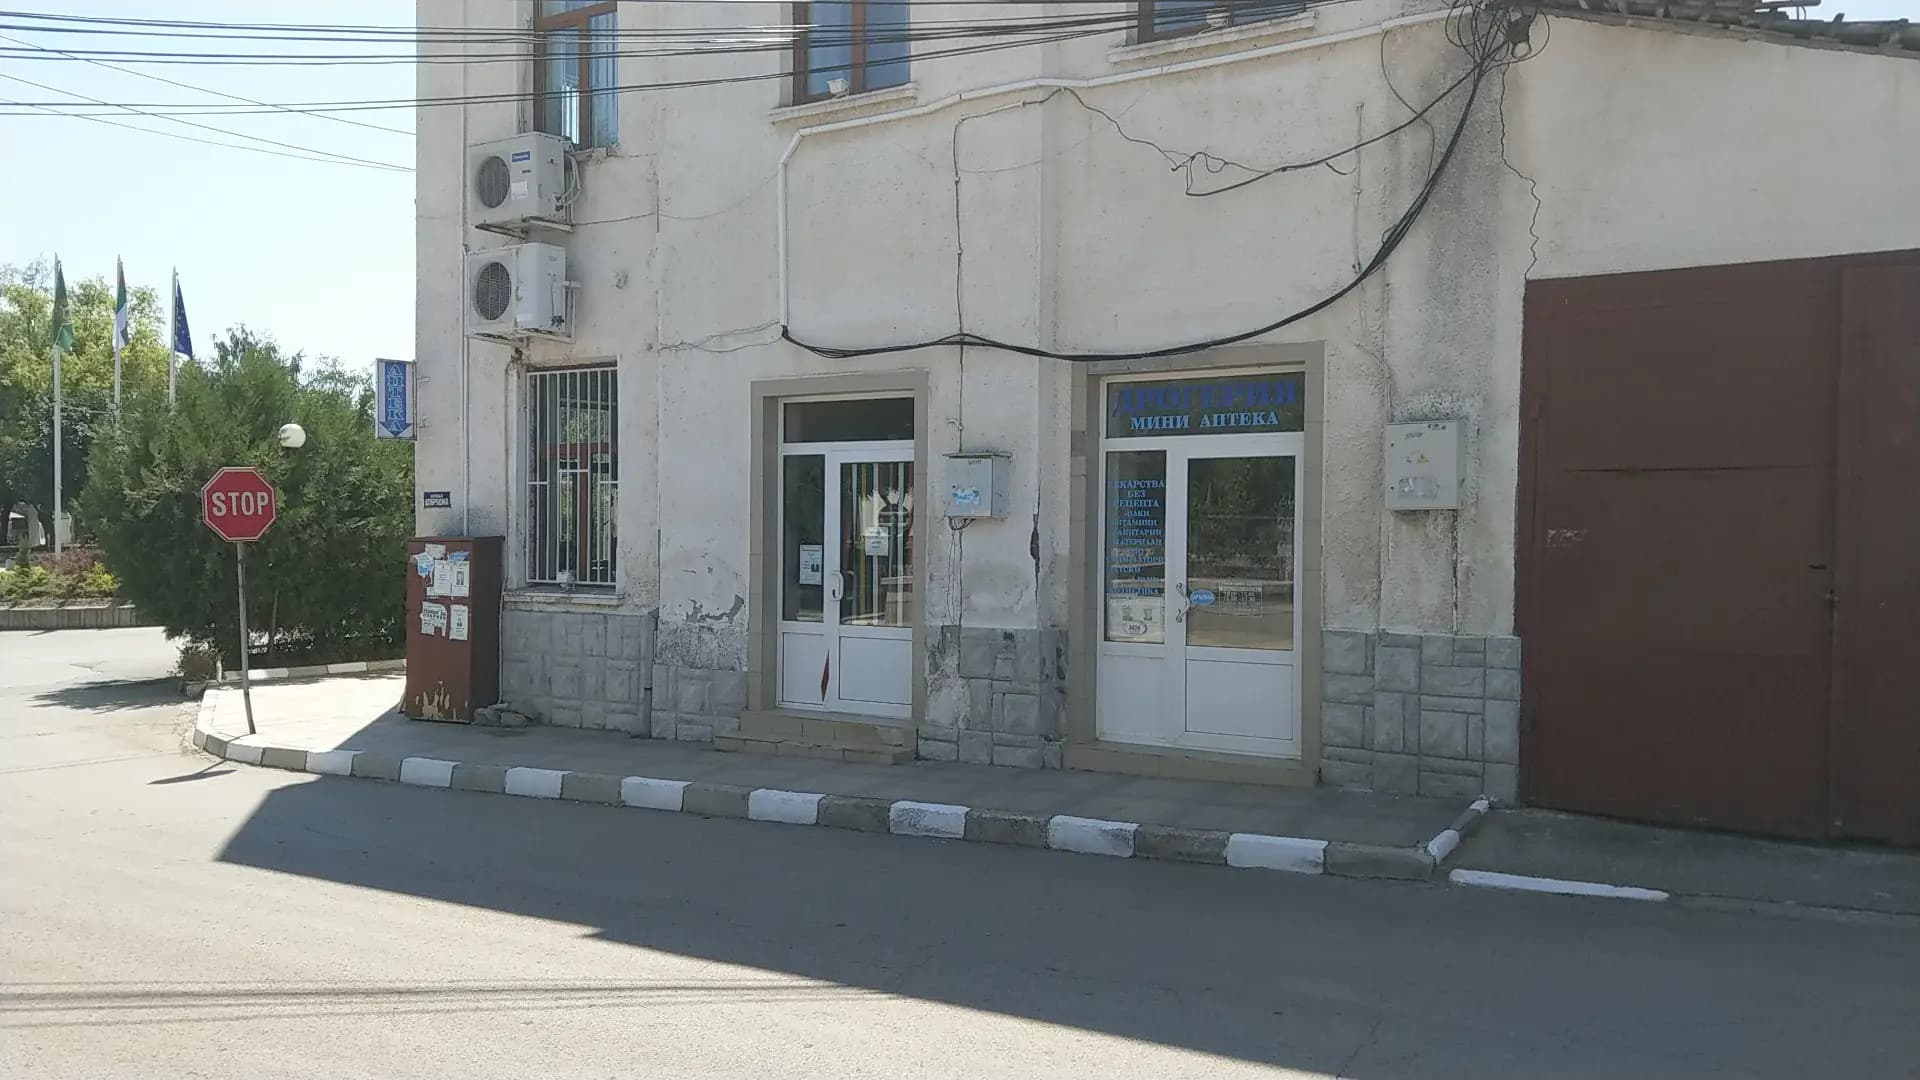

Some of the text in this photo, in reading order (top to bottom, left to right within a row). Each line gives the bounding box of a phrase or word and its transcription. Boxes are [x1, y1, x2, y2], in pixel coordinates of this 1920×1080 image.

[387, 364, 404, 432] АПТЕКА
[1112, 381, 1297, 417] ДРОГЕРИЯ
[1129, 410, 1279, 430] МИНИ АПТЕКА
[211, 491, 269, 517] STOP
[1113, 499, 1160, 508] ЕЦЕПТА
[1127, 490, 1146, 498] БЕЗ
[1112, 519, 1159, 527] ИТАМИНИ
